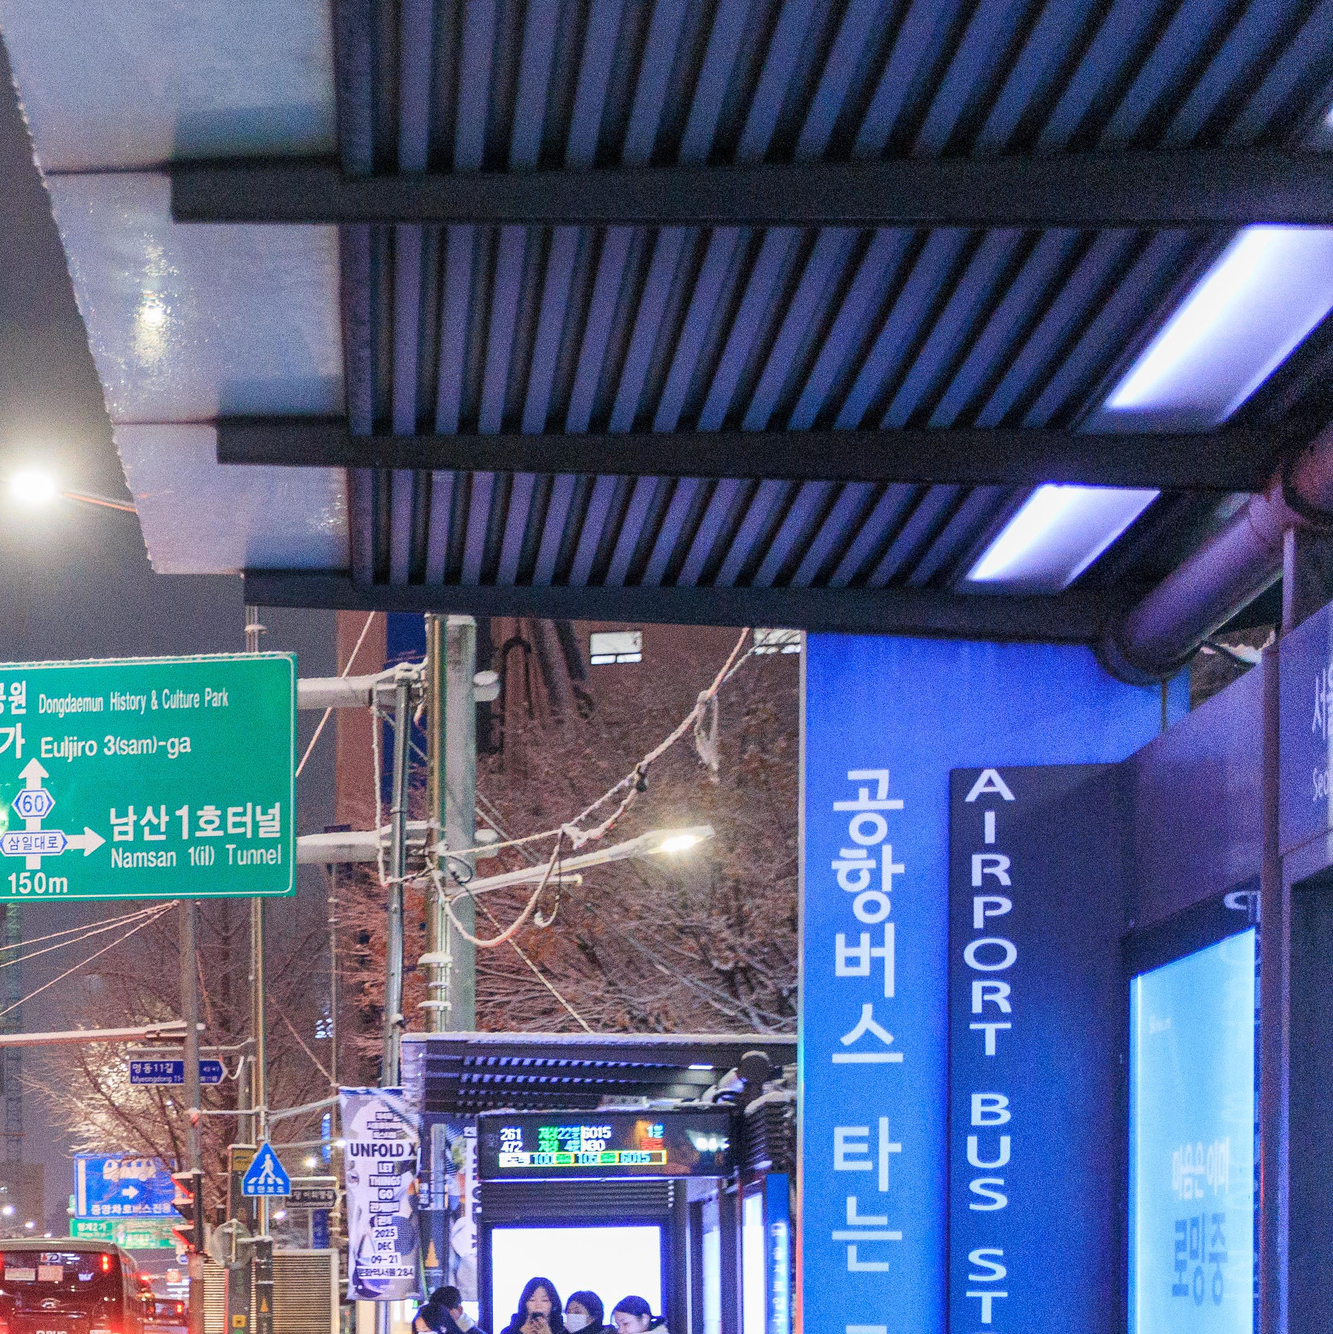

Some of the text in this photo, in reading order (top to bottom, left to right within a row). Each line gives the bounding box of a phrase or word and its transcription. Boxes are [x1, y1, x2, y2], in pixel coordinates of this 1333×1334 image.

[38, 690, 228, 714] Dongdaemun History & Culture Park
[41, 734, 191, 763] Euljiro 3(sam)-ga
[22, 795, 45, 813] 60
[8, 836, 59, 851] 삼일대로
[110, 846, 282, 867] Namsan 1(il) Tunnel
[8, 872, 68, 894] 150m
[832, 769, 904, 1063] 공항버스
[963, 768, 1018, 1056] AIRPORT
[500, 1128, 522, 1141] 261
[350, 1143, 418, 1157] UNFOLD X
[500, 1141, 522, 1152] 472
[966, 1093, 1011, 1211] BUS
[379, 1163, 393, 1173] LET
[379, 1190, 393, 1199] GO
[832, 1117, 902, 1272] 타는
[375, 1229, 395, 1238] 2025
[377, 1242, 392, 1251] DEC
[1171, 1212, 1229, 1307] 로밍중
